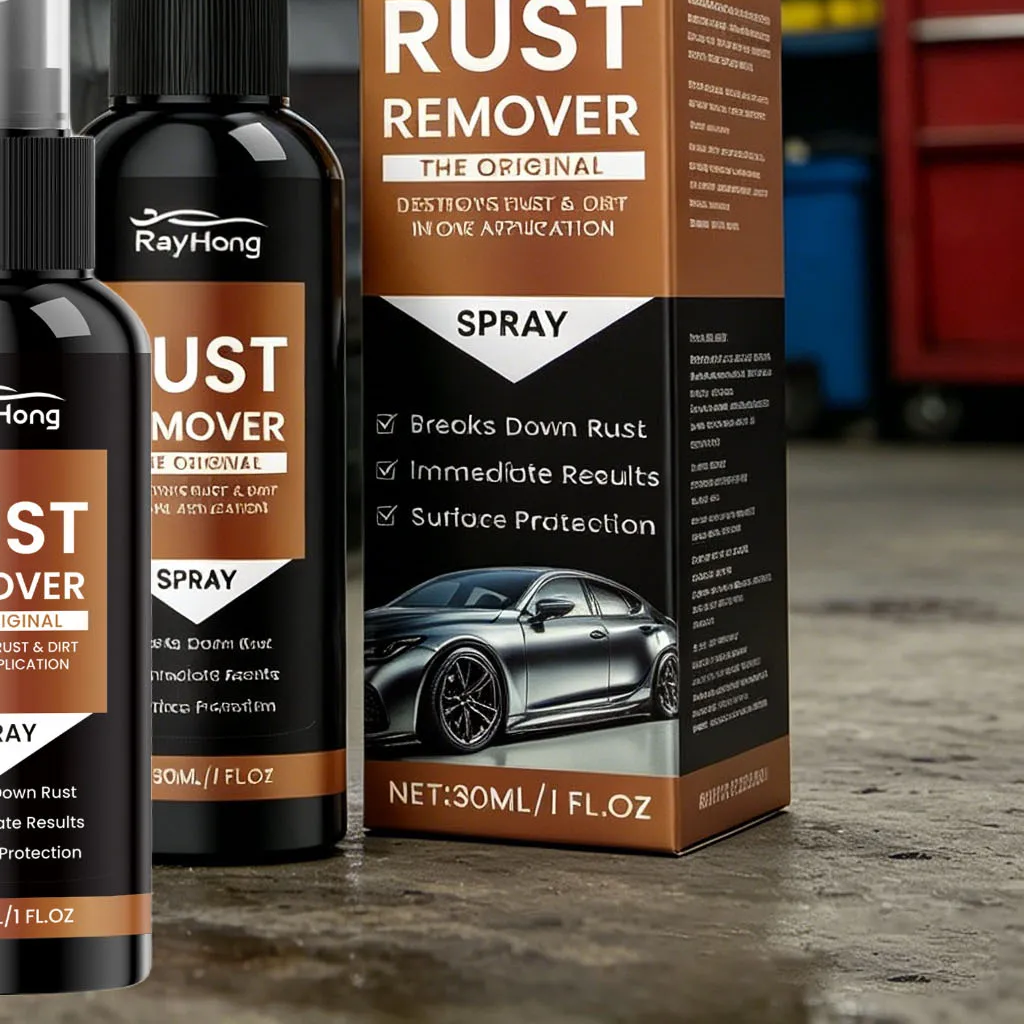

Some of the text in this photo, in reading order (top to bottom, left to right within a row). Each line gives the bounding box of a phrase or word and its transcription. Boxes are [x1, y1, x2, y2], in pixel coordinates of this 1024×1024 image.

[383, 93, 640, 139] REMOVER
[420, 156, 604, 176] THE ORIGINAL
[412, 221, 432, 237] IN
[135, 229, 261, 259] RayHong
[457, 309, 568, 338] SPRAY
[154, 335, 289, 394] UST
[151, 411, 285, 441] MOVER
[506, 416, 577, 437] Down
[588, 419, 648, 439] Rust
[157, 568, 237, 590] SPRAY
[33, 641, 44, 653] &
[48, 641, 79, 653] DIRT
[41, 785, 77, 799] Rust
[569, 791, 651, 820] FL.OZ
[26, 815, 85, 829] Results
[0, 846, 82, 860] Protection
[26, 908, 75, 924] FL.OZ
